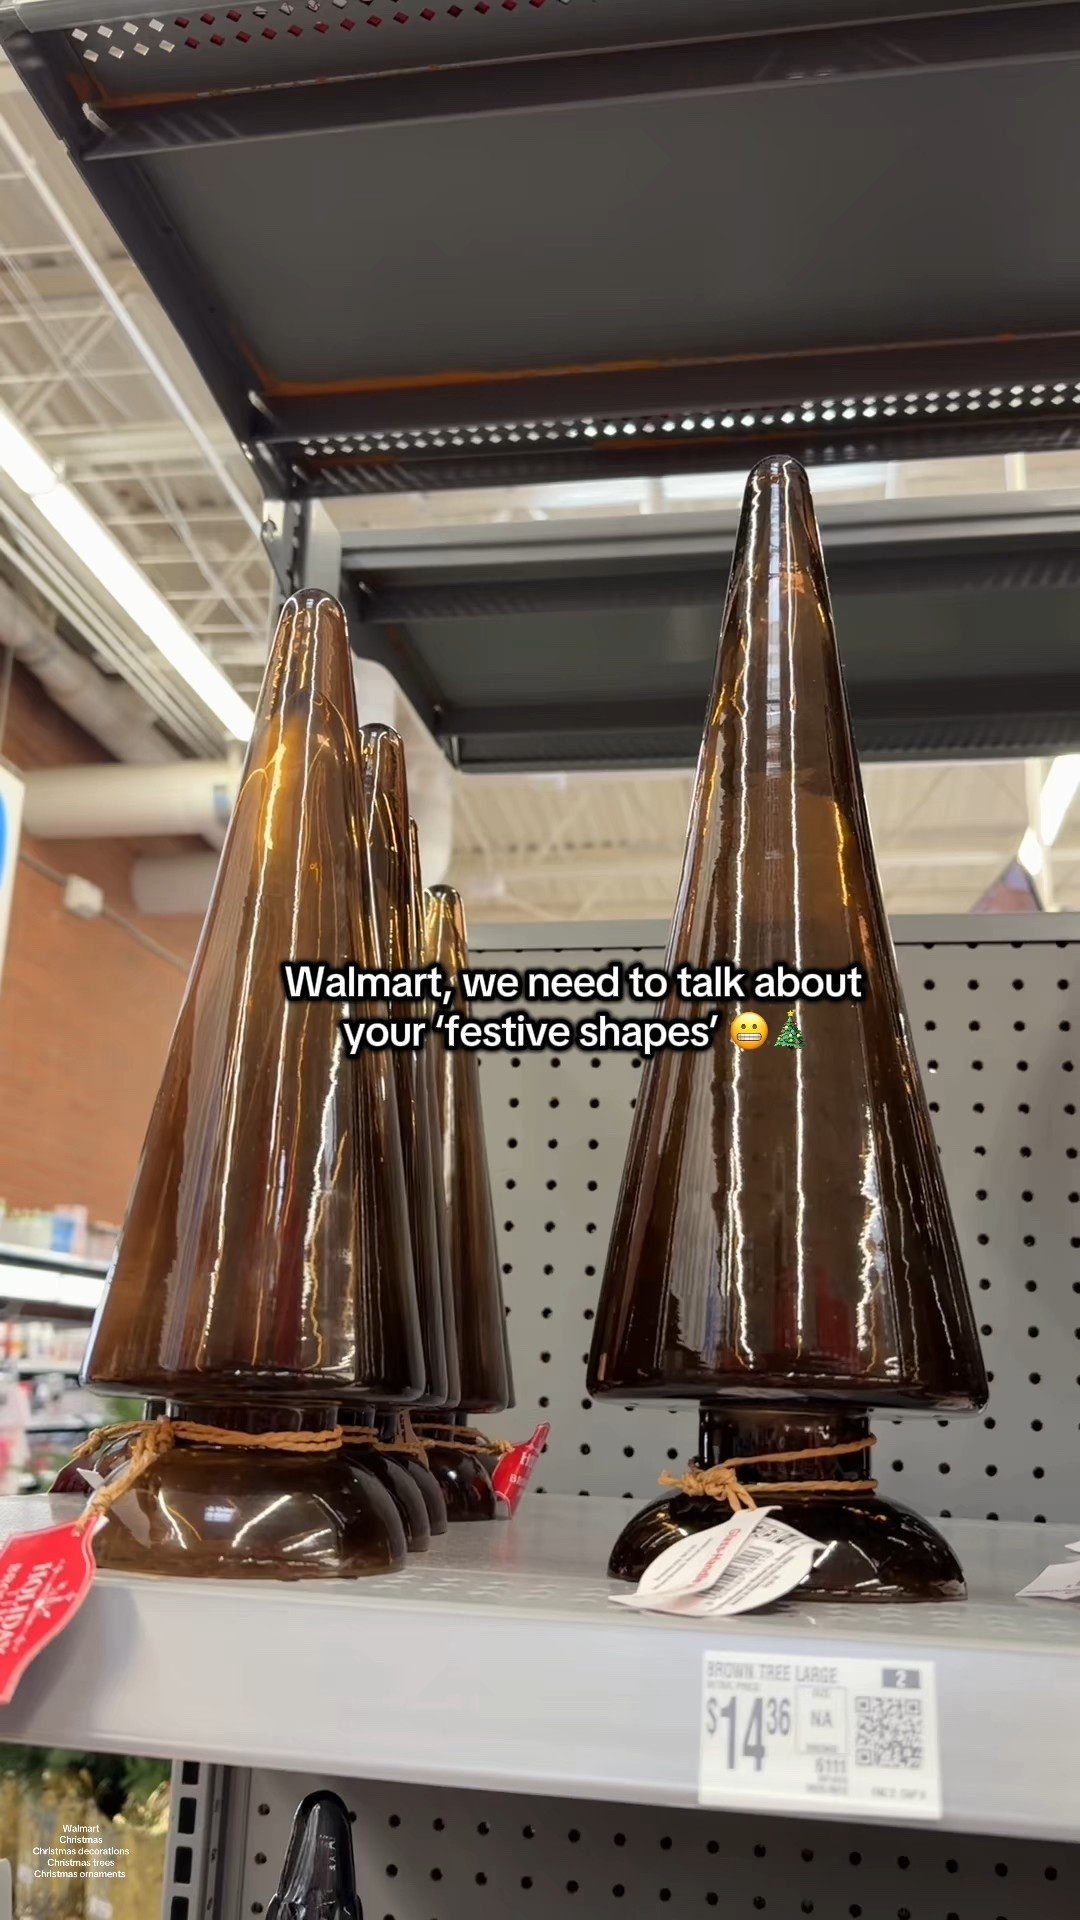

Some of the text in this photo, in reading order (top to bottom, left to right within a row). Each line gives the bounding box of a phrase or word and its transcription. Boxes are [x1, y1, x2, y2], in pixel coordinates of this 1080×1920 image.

[706, 1660, 839, 1684] BROWN TREE LARGE
[895, 1670, 907, 1688] 2
[810, 1709, 833, 1728] NA
